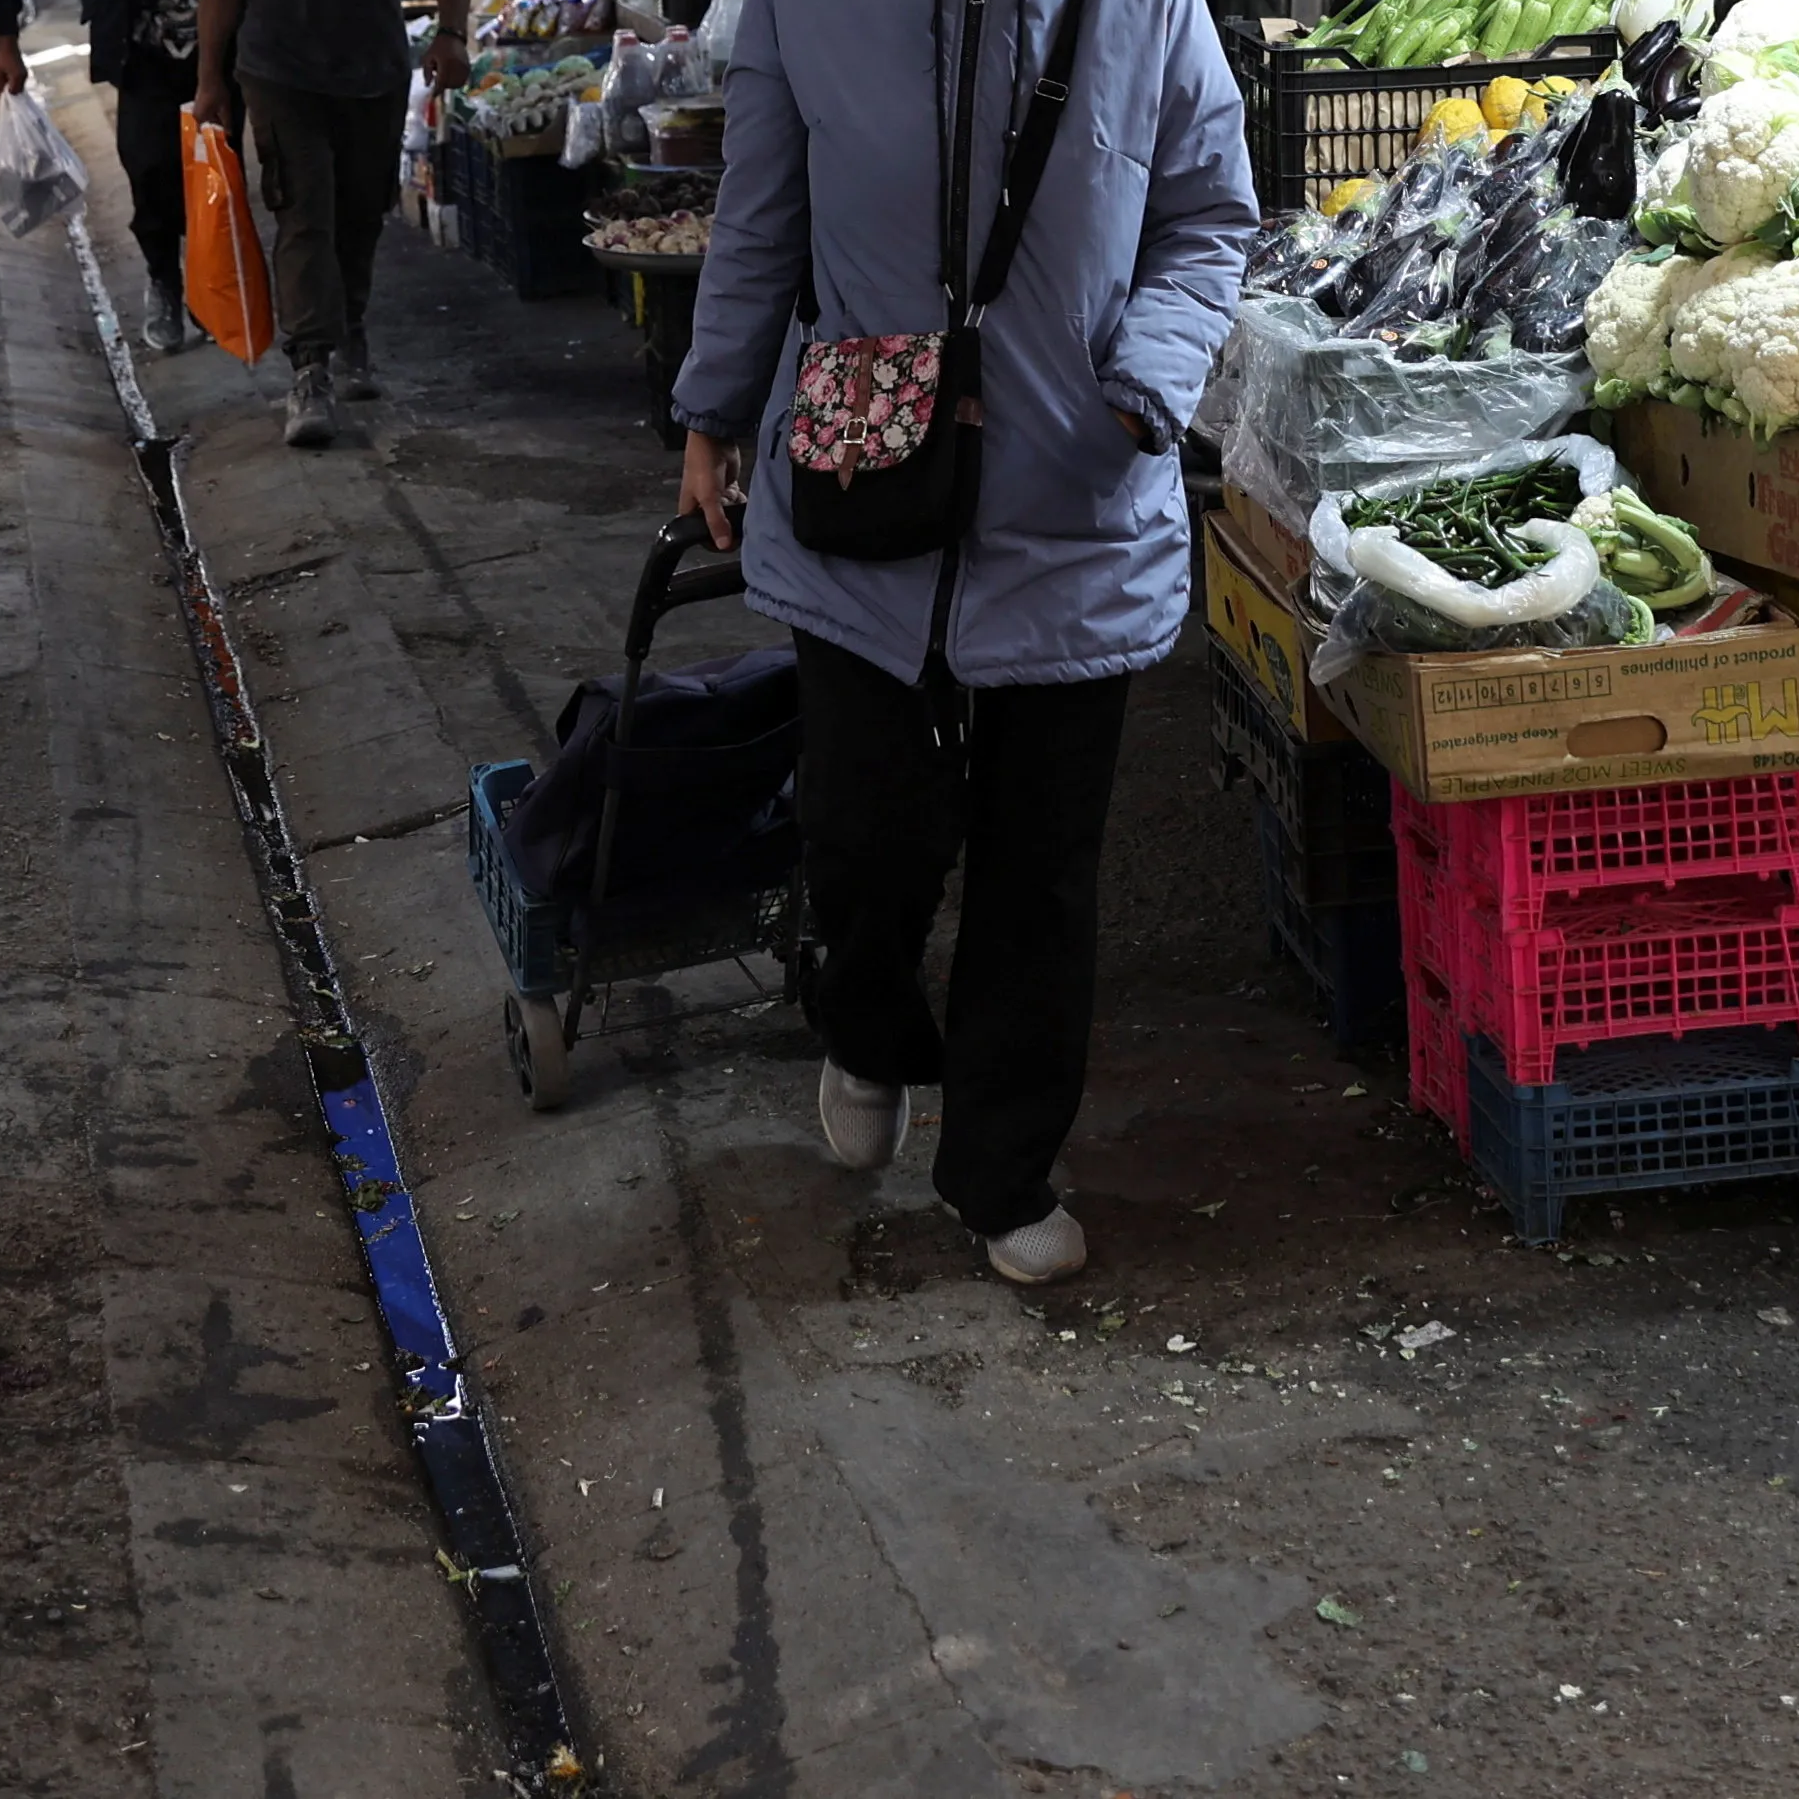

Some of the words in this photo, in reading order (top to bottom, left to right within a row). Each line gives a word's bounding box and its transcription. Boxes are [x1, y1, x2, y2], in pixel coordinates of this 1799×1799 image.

[1620, 655, 1709, 677] philippines
[1712, 654, 1730, 669] of
[1732, 645, 1797, 665] product
[1431, 730, 1517, 752] Refrigerated
[1522, 726, 1559, 742] Keep
[1561, 762, 1612, 784] MD2
[1619, 757, 1687, 779] SWEET
[1440, 770, 1555, 796] PINEAPPLE
